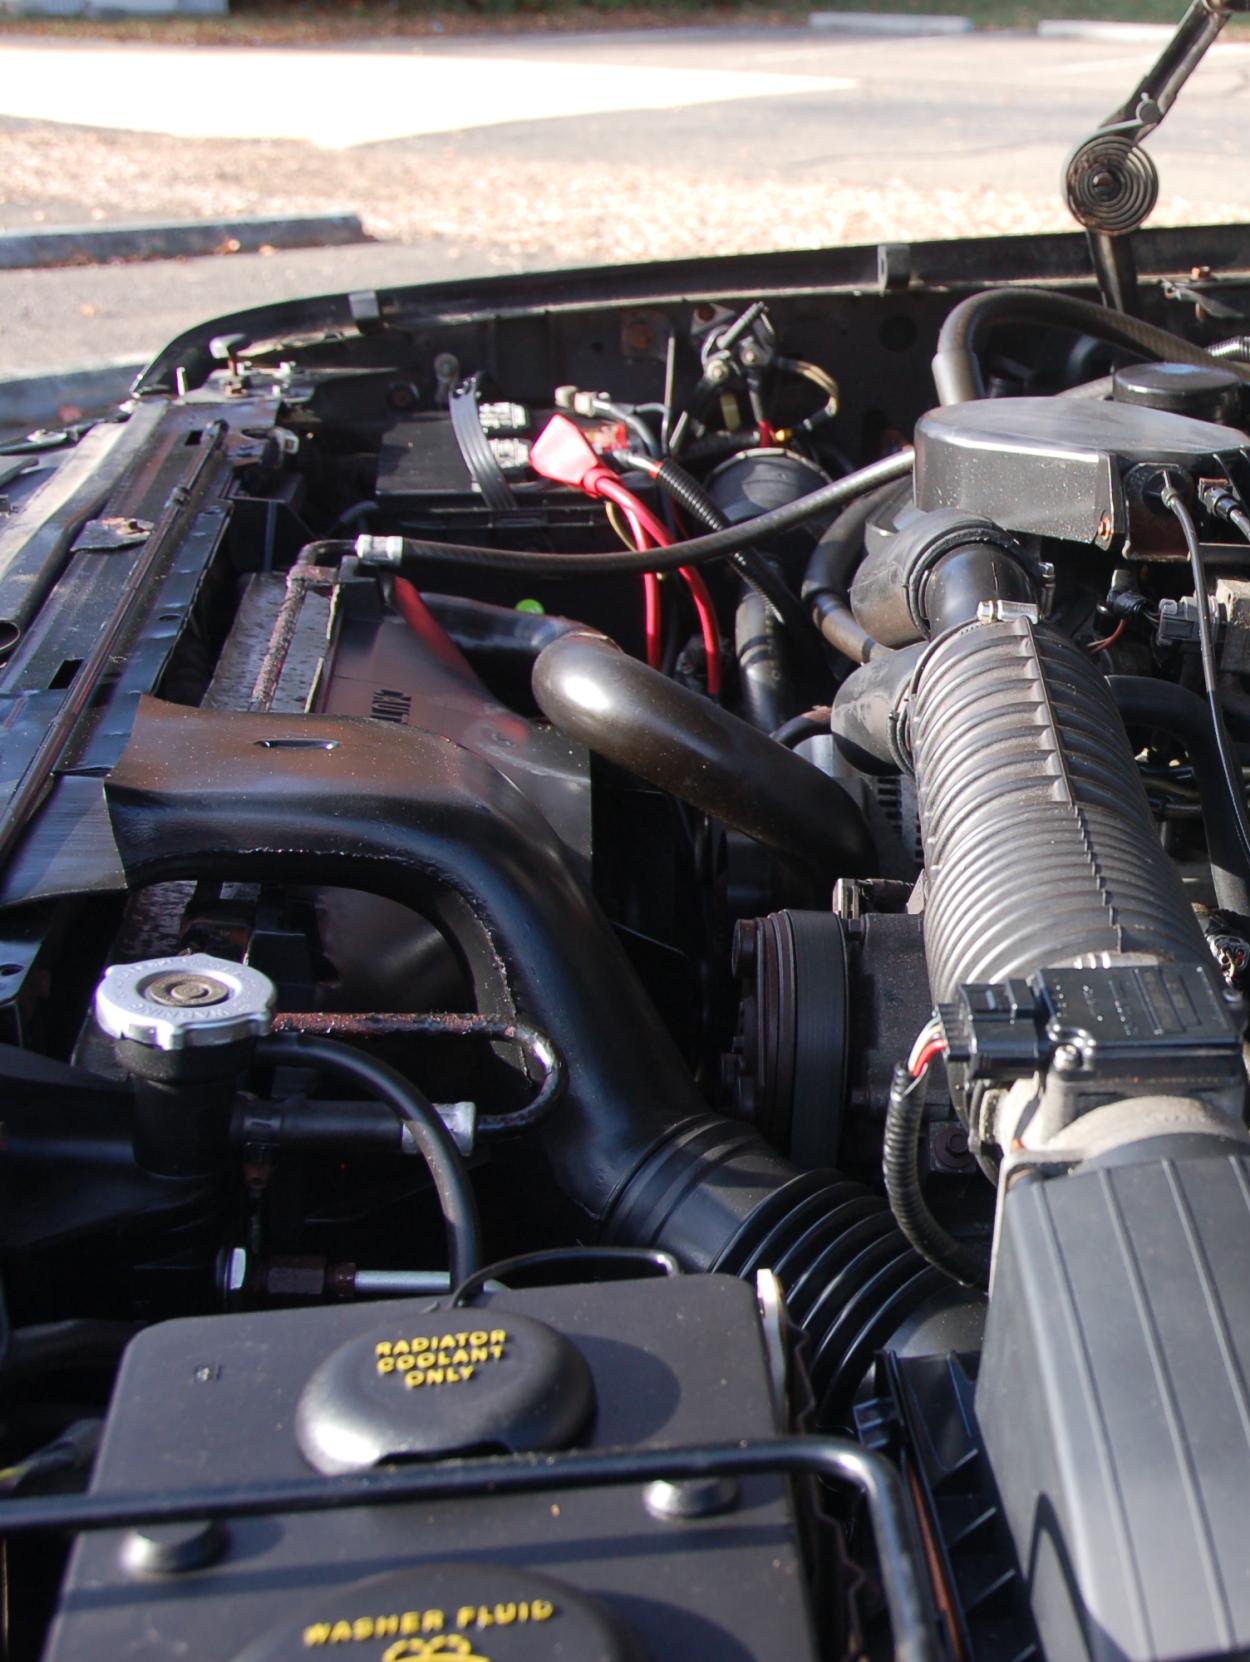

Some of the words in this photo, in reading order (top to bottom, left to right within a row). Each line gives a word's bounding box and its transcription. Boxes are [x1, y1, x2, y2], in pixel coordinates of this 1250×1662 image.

[376, 1329, 506, 1356] RADIATOR
[377, 1345, 505, 1374] COOLANT
[405, 1366, 475, 1389] ONLY
[304, 1610, 444, 1645] WASHER
[457, 1599, 554, 1629] FLUID
